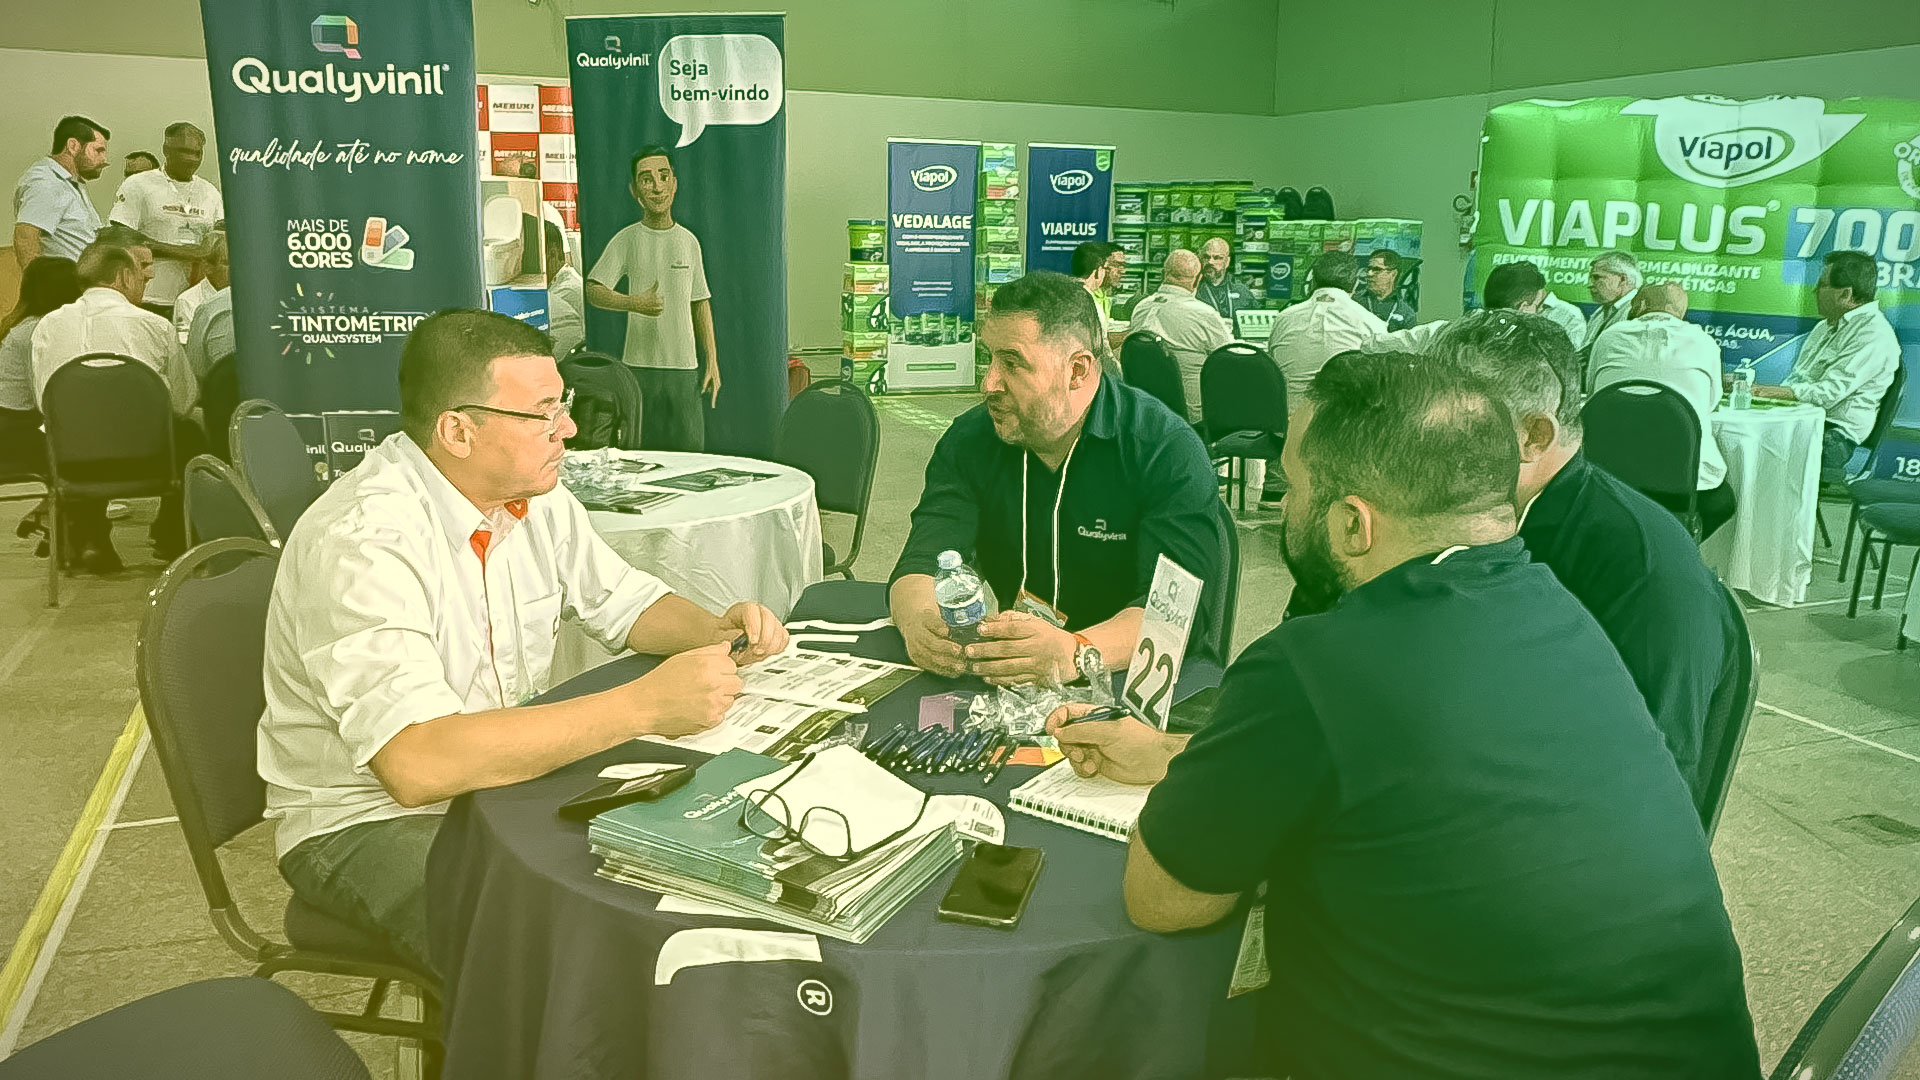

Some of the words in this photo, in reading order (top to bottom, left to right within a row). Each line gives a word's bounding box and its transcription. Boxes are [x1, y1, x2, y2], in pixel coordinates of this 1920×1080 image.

[576, 53, 650, 70] Qualyvinil
[669, 59, 709, 81] Seja
[670, 83, 770, 102] bem-vindo
[230, 137, 332, 175] qualidade
[335, 138, 371, 174] até
[374, 151, 402, 165] no
[406, 149, 464, 165] nome
[1678, 135, 1773, 171] Viapol
[910, 169, 949, 187] Viapol
[1049, 173, 1086, 190] Viapol
[287, 219, 326, 232] MAIS
[329, 219, 349, 231] DE
[892, 214, 972, 230] VEDALAGE
[1041, 222, 1097, 236] VIAPLUS
[1498, 198, 1769, 255] VIAPLUS
[287, 232, 352, 251] 6.000
[288, 251, 354, 269] CORES
[287, 311, 427, 332] TINTOMÉTRIC
[302, 334, 382, 344] QUALYSYSTEM
[1724, 323, 1775, 342] ÁGUA,
[1125, 637, 1174, 730] 22
